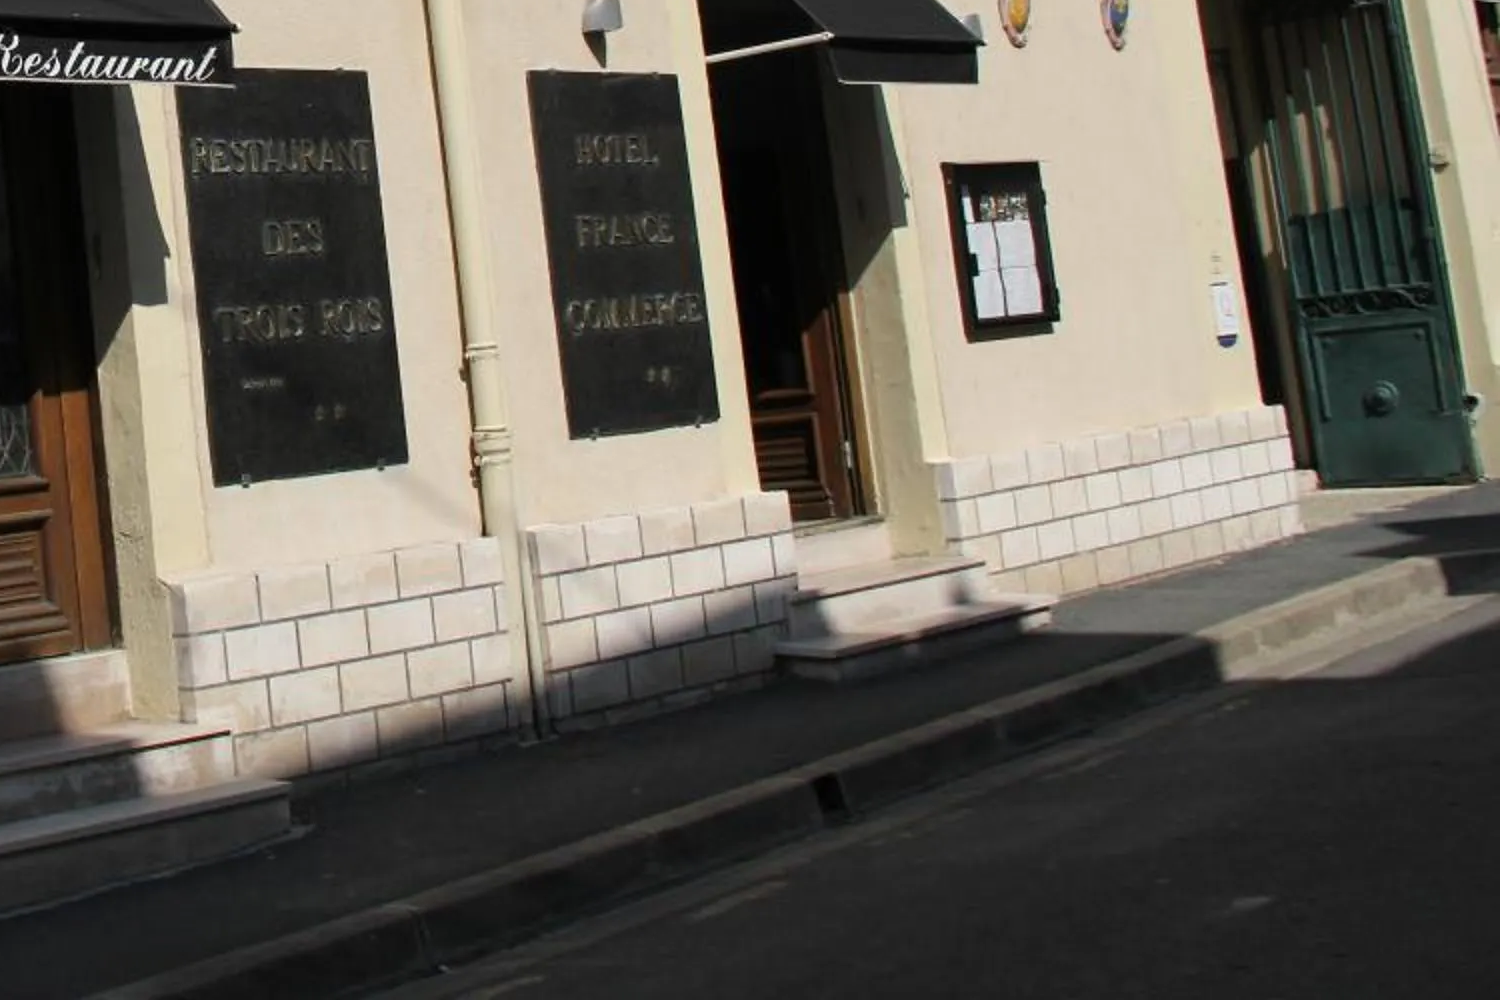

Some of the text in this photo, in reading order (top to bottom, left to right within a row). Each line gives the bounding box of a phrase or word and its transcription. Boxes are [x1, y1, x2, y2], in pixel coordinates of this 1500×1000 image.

[190, 136, 374, 178] RESTAURANT
[573, 133, 660, 166] HOTEL
[261, 218, 326, 258] DES
[574, 211, 675, 248] FRANCE
[212, 295, 385, 344] TROIS ROIS
[564, 292, 704, 334] COMMERCE
